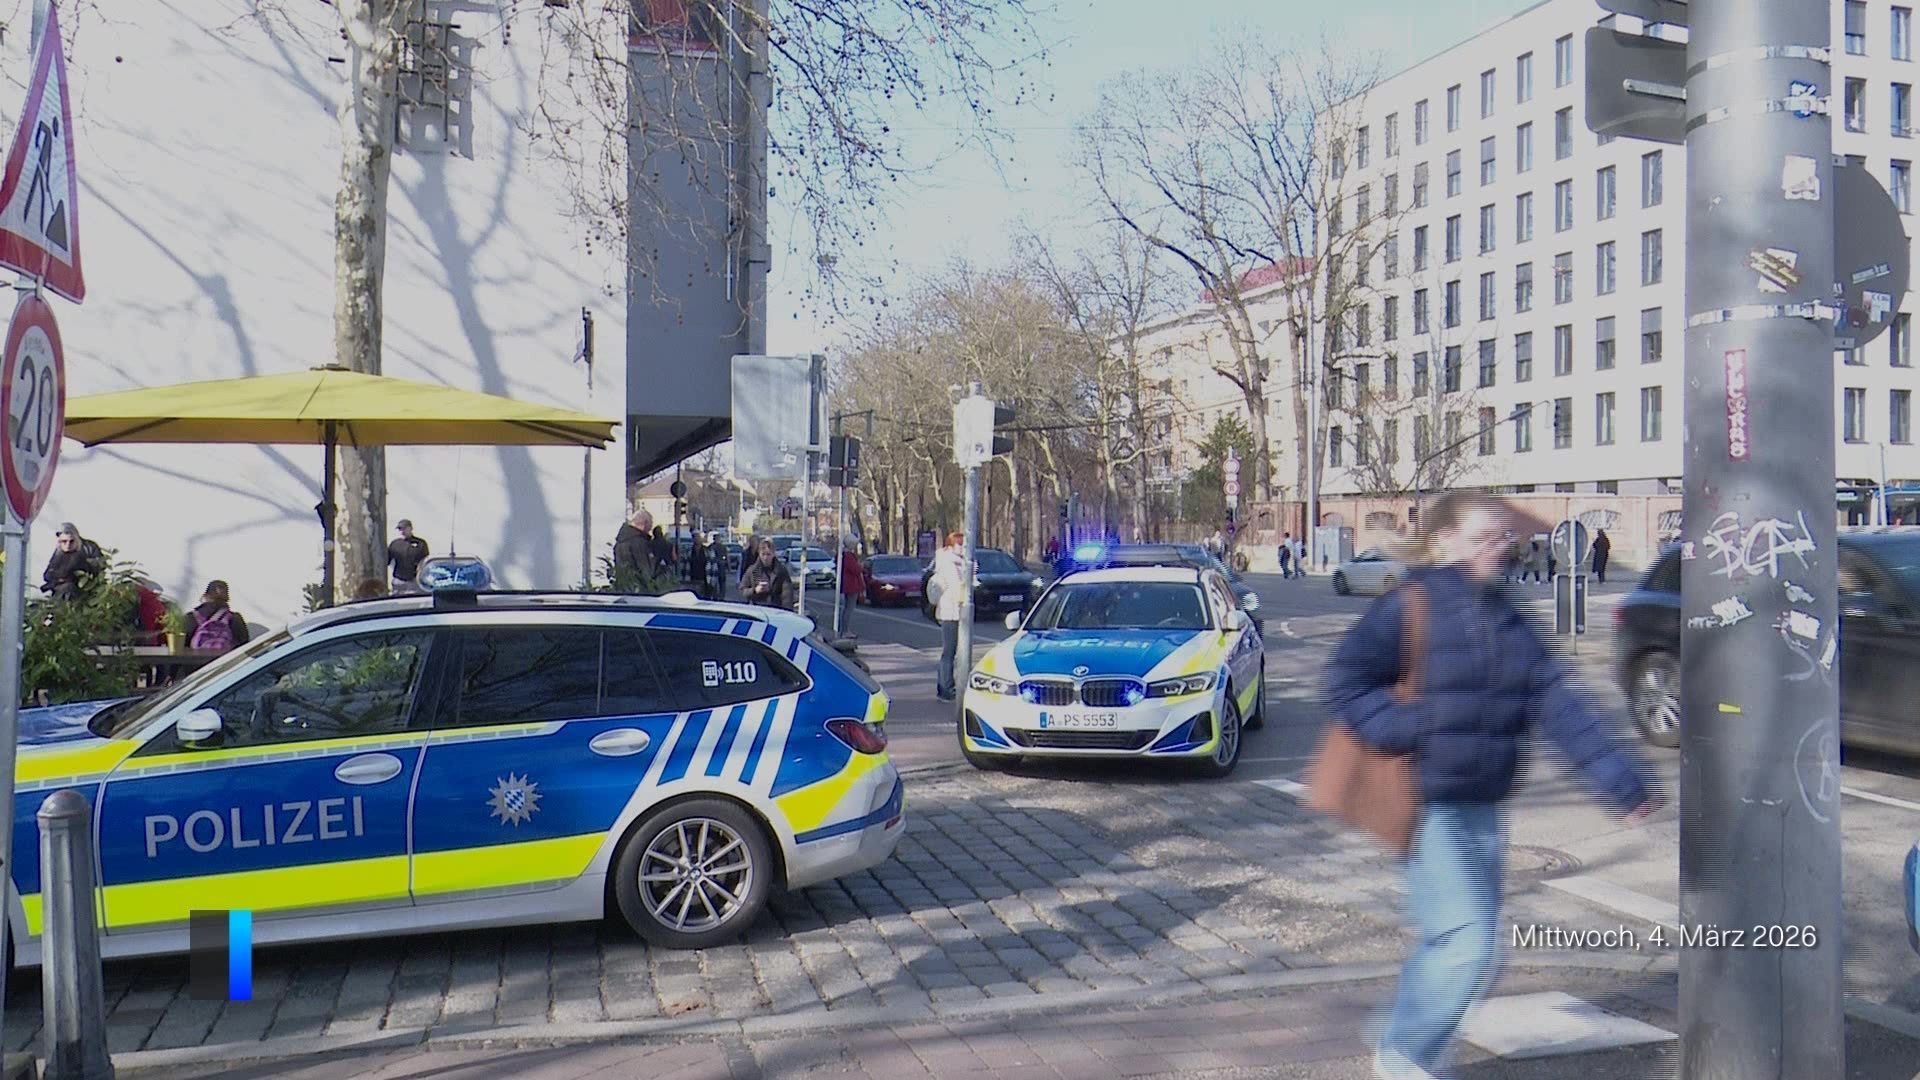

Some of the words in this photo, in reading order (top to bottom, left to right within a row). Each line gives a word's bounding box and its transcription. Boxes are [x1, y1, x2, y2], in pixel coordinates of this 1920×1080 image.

[15, 355, 54, 458] 20
[1041, 638, 1150, 649] POLIZEI
[724, 661, 757, 683] 110
[1048, 714, 1056, 727] A
[1064, 714, 1080, 727] PS
[1084, 713, 1116, 727] 5553
[144, 795, 365, 858] POLIZEI
